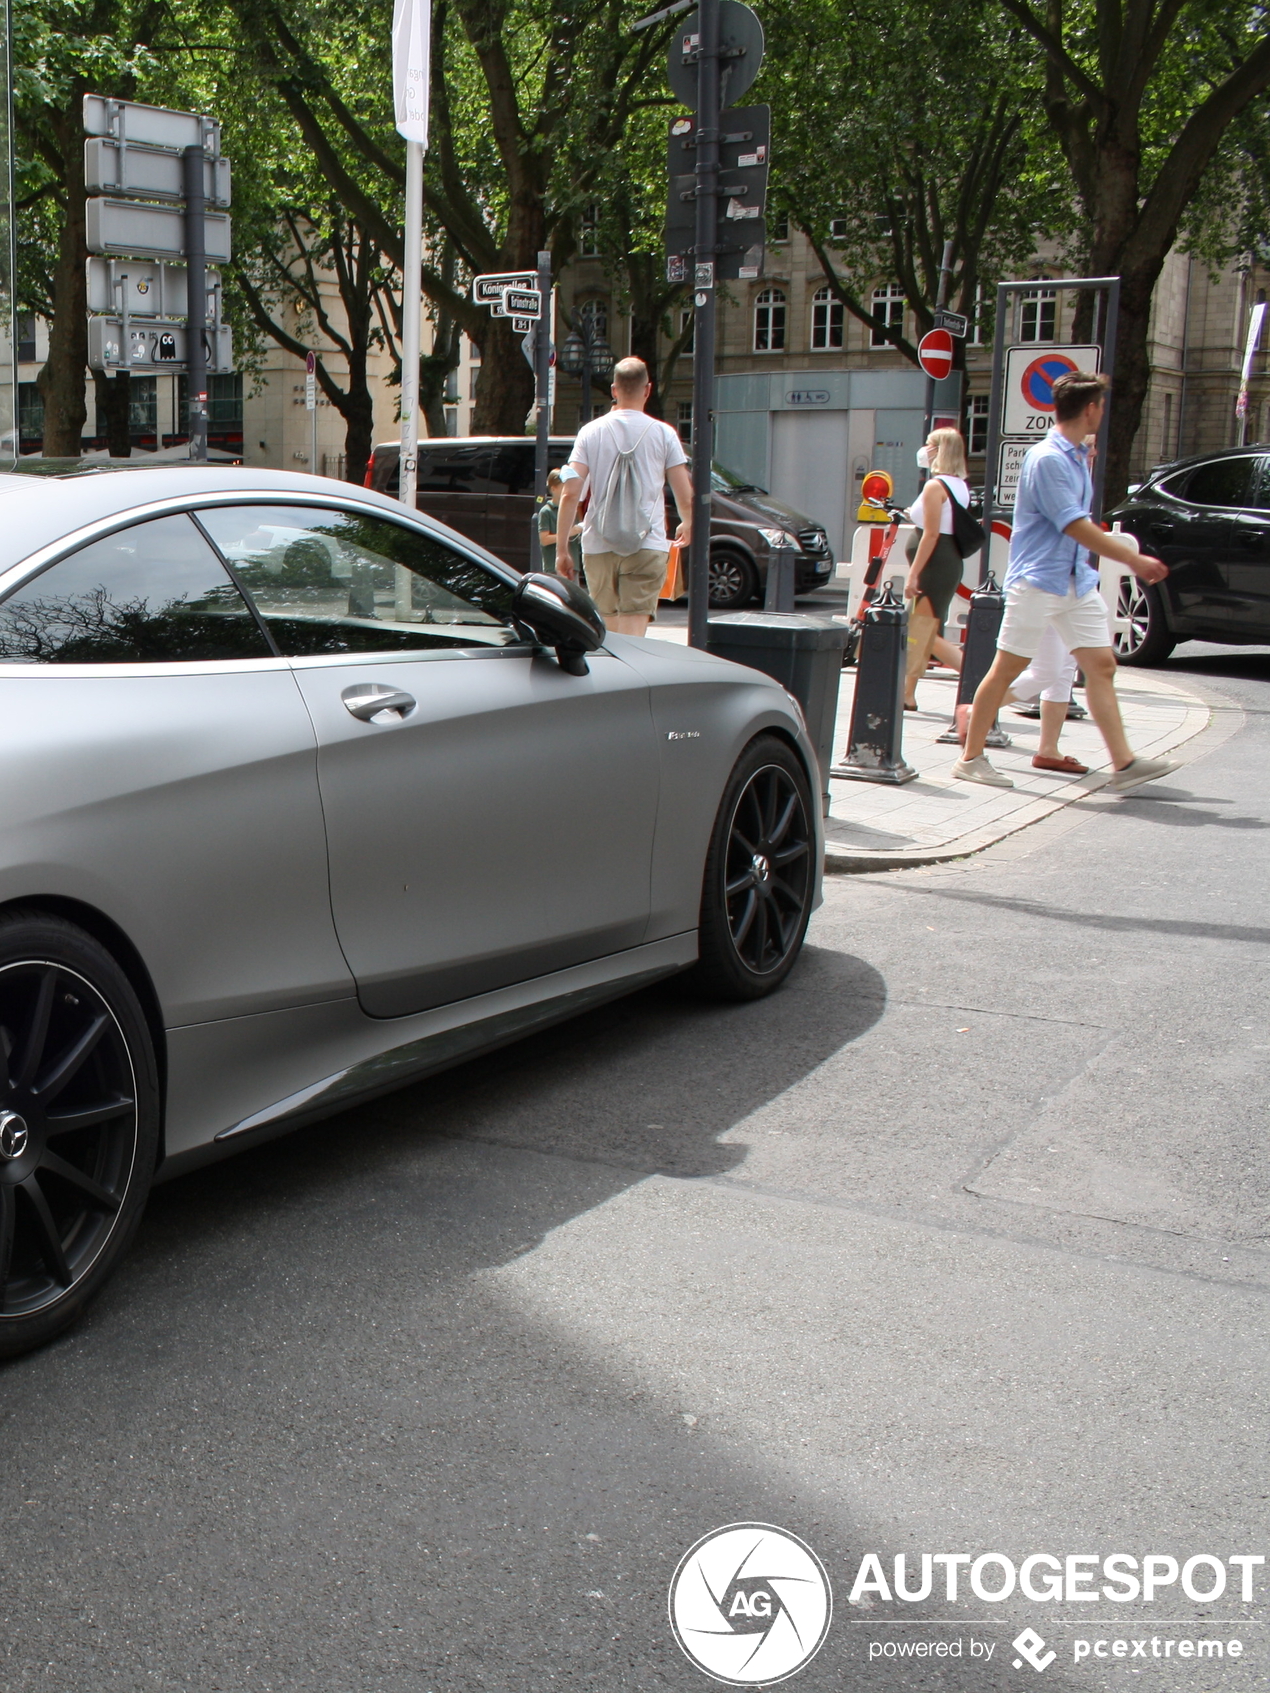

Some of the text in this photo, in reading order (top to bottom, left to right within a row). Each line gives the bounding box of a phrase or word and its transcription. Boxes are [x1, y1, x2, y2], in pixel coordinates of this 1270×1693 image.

[1025, 416, 1056, 430] ZON
[1007, 447, 1027, 458] Park
[1005, 461, 1022, 471] sch
[1003, 493, 1016, 501] we
